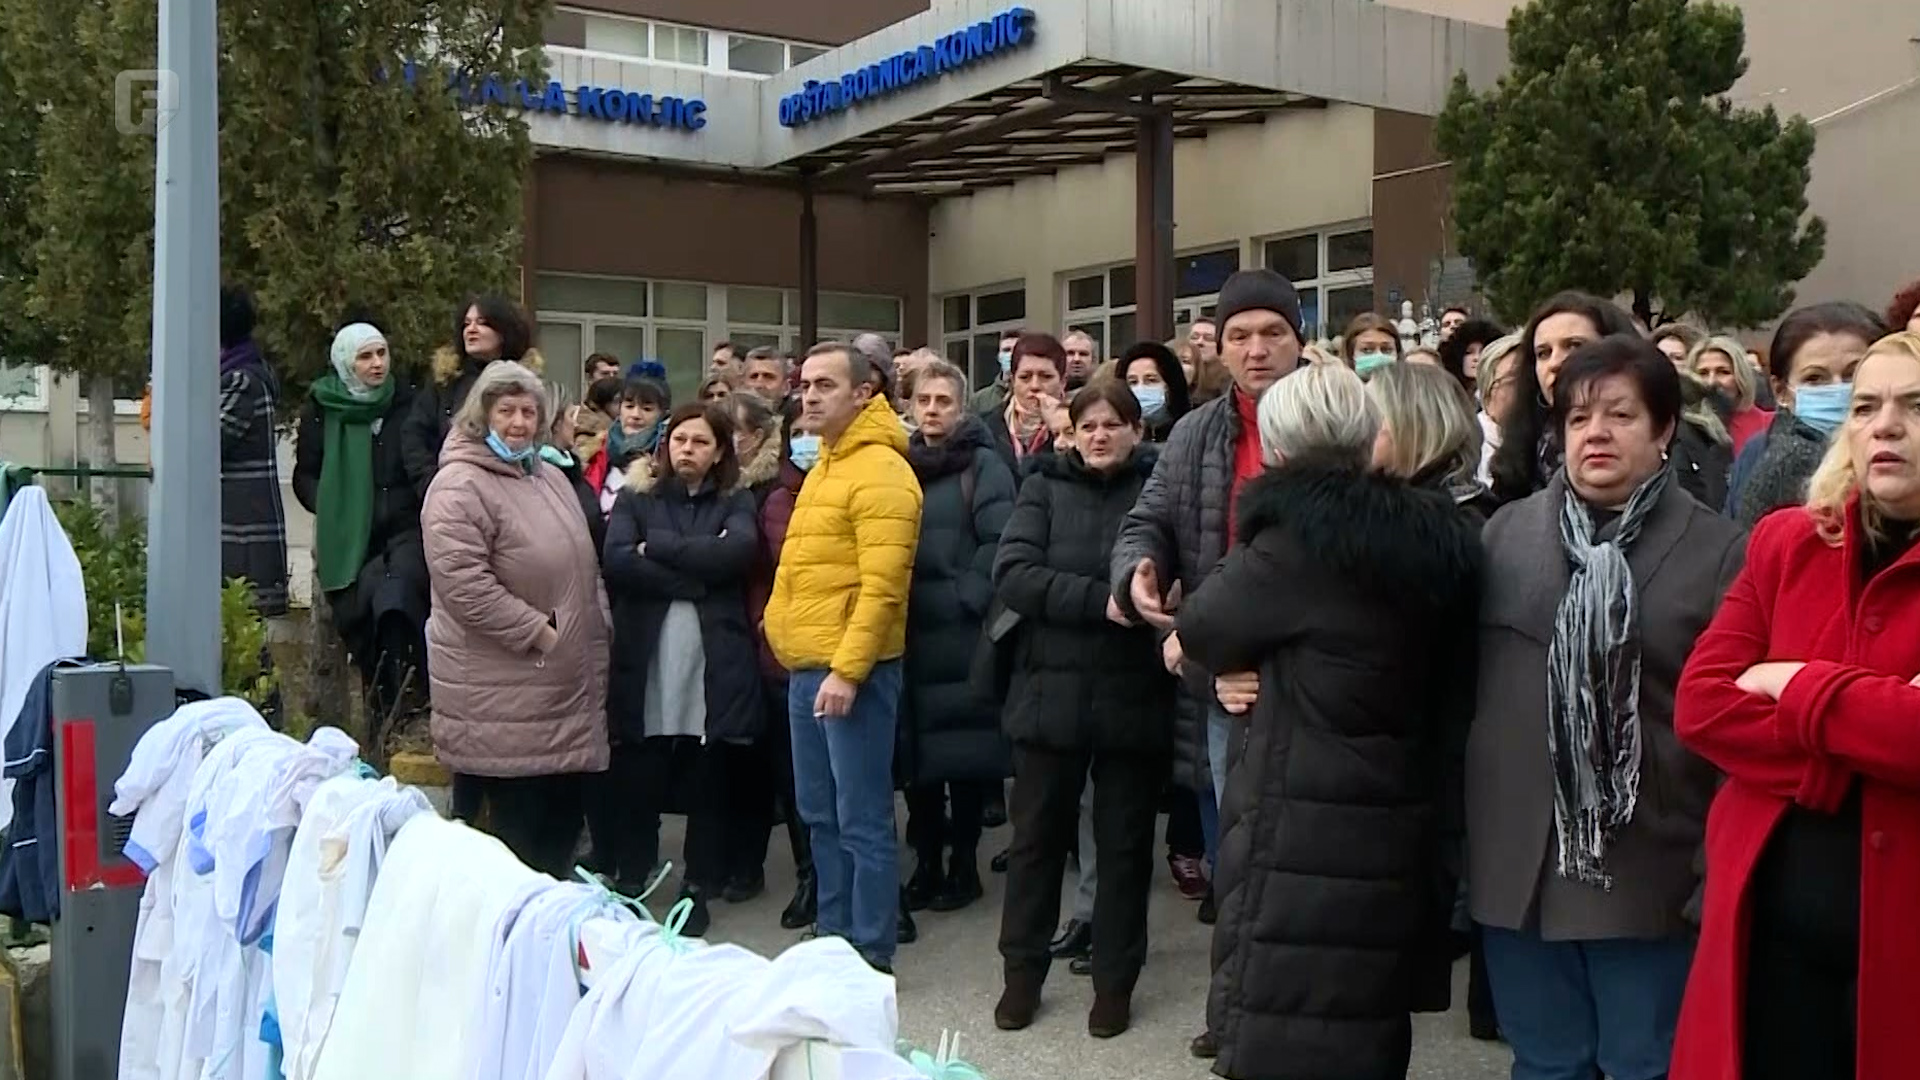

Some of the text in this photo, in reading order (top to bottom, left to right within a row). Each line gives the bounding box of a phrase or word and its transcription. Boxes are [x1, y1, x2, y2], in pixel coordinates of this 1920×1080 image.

[579, 85, 707, 131] KONJIC
[779, 8, 1034, 128] OPŠTA BOLNICA KONJIC
